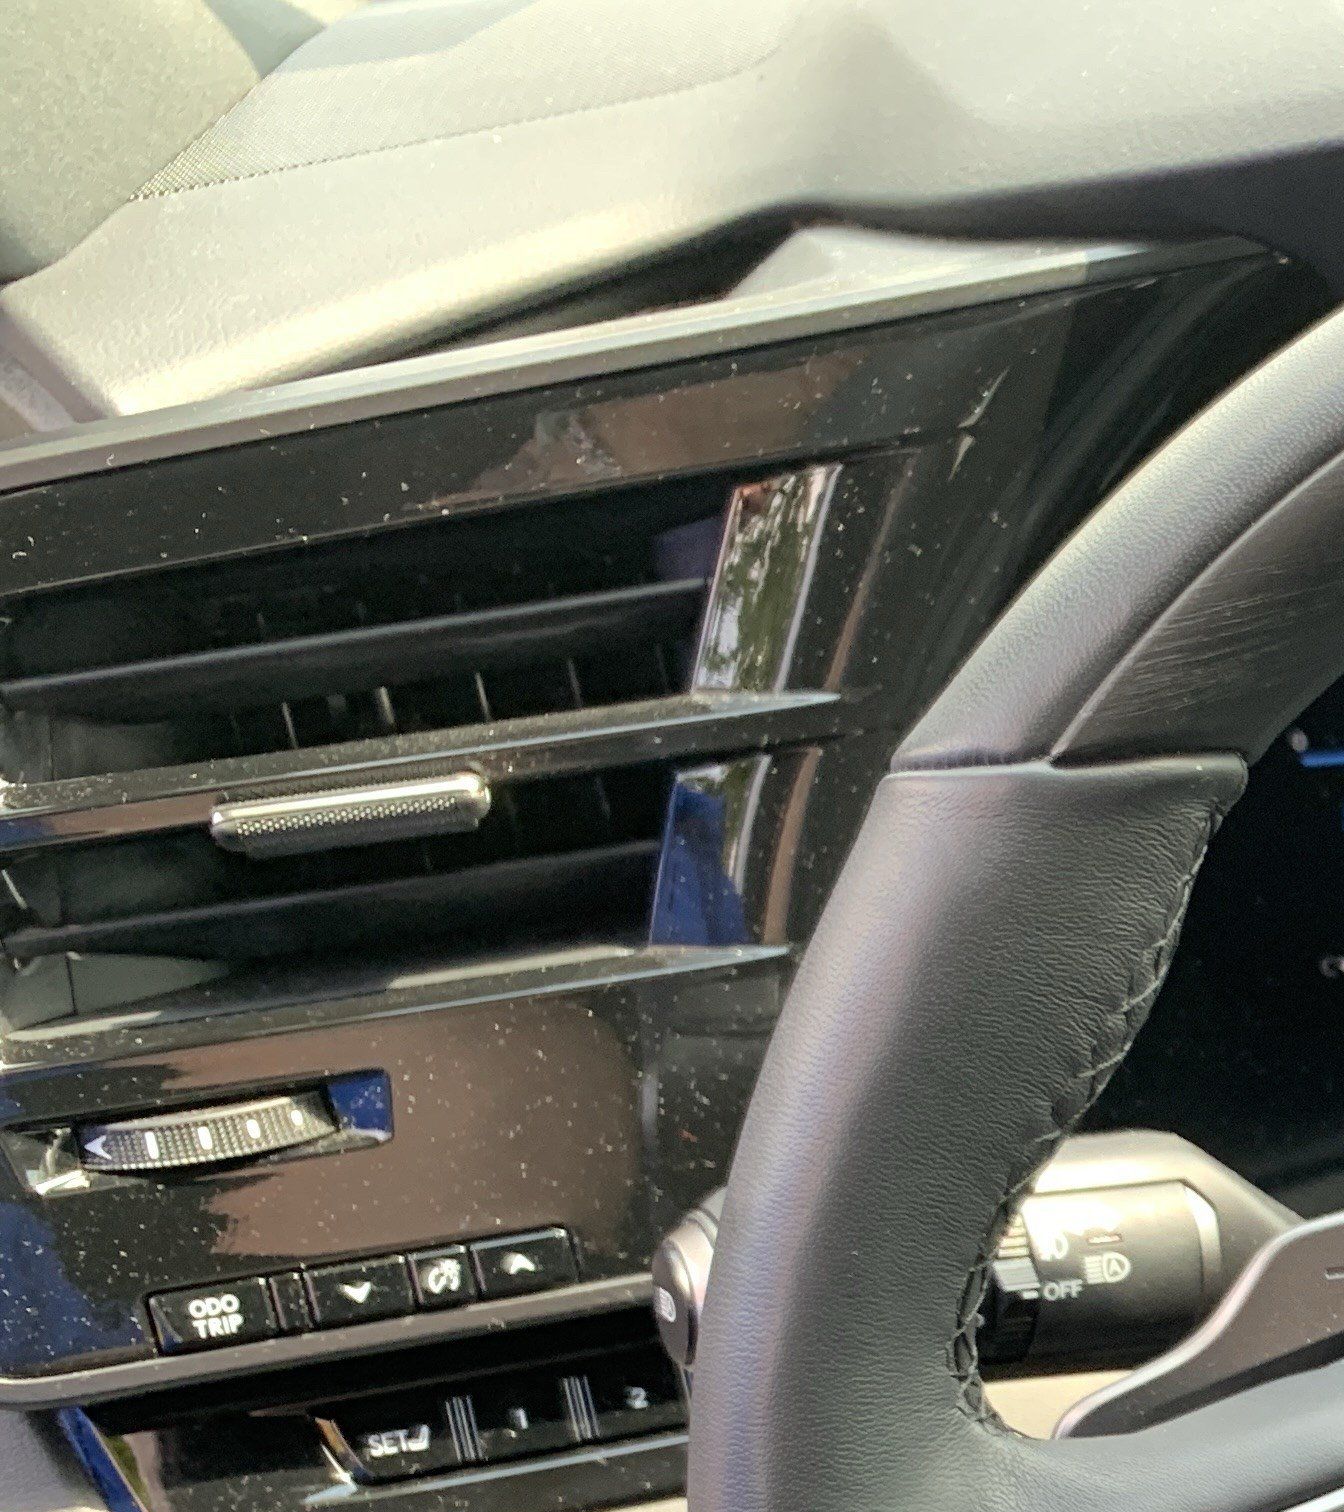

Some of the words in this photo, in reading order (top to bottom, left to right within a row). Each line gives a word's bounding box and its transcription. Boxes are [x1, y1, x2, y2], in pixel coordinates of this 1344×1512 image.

[1042, 1278, 1084, 1301] OFF
[188, 1294, 240, 1320] ODO
[192, 1312, 245, 1340] TRIP
[628, 1386, 649, 1409] 2
[367, 1428, 409, 1458] SET
